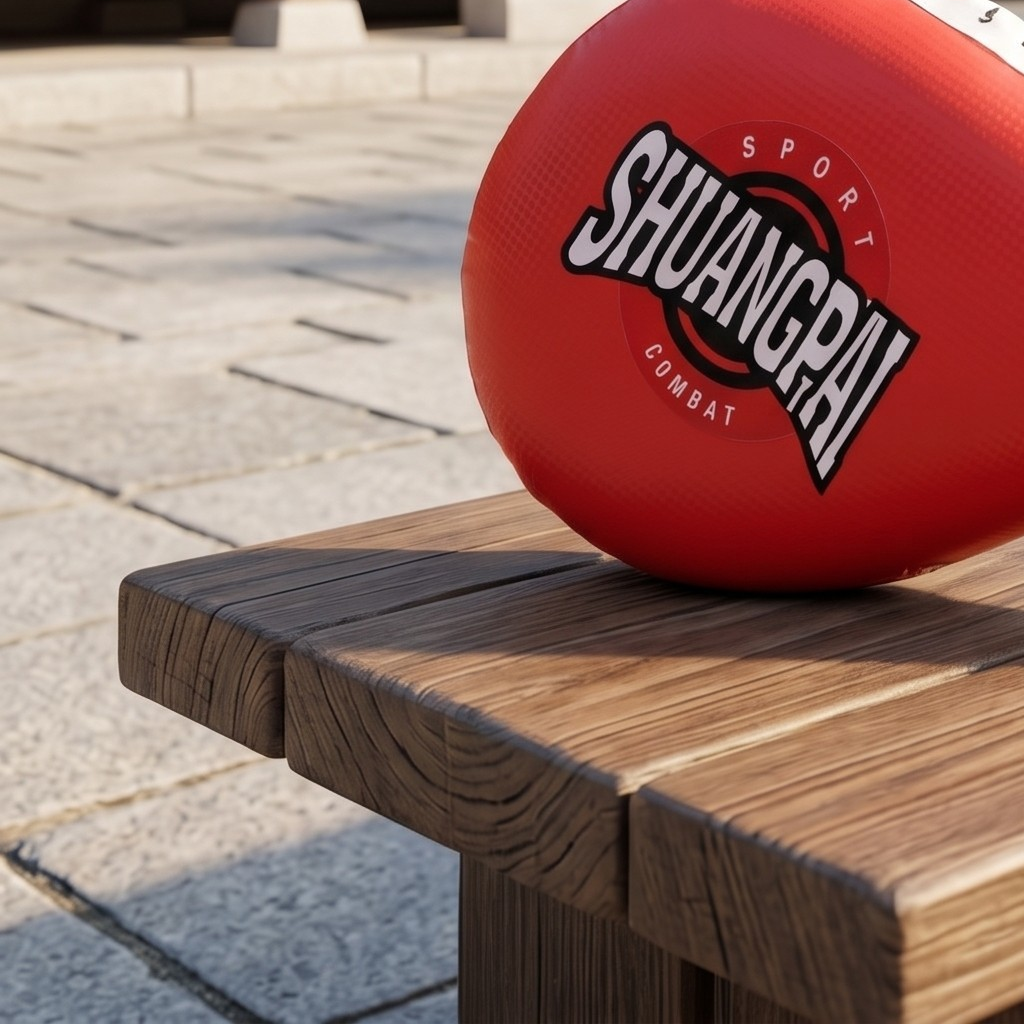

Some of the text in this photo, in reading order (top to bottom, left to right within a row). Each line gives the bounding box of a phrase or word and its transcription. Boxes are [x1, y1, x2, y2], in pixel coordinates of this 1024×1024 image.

[742, 135, 874, 247] SPORT
[567, 128, 911, 480] SHUANGPAI
[644, 343, 736, 426] COMBAT
